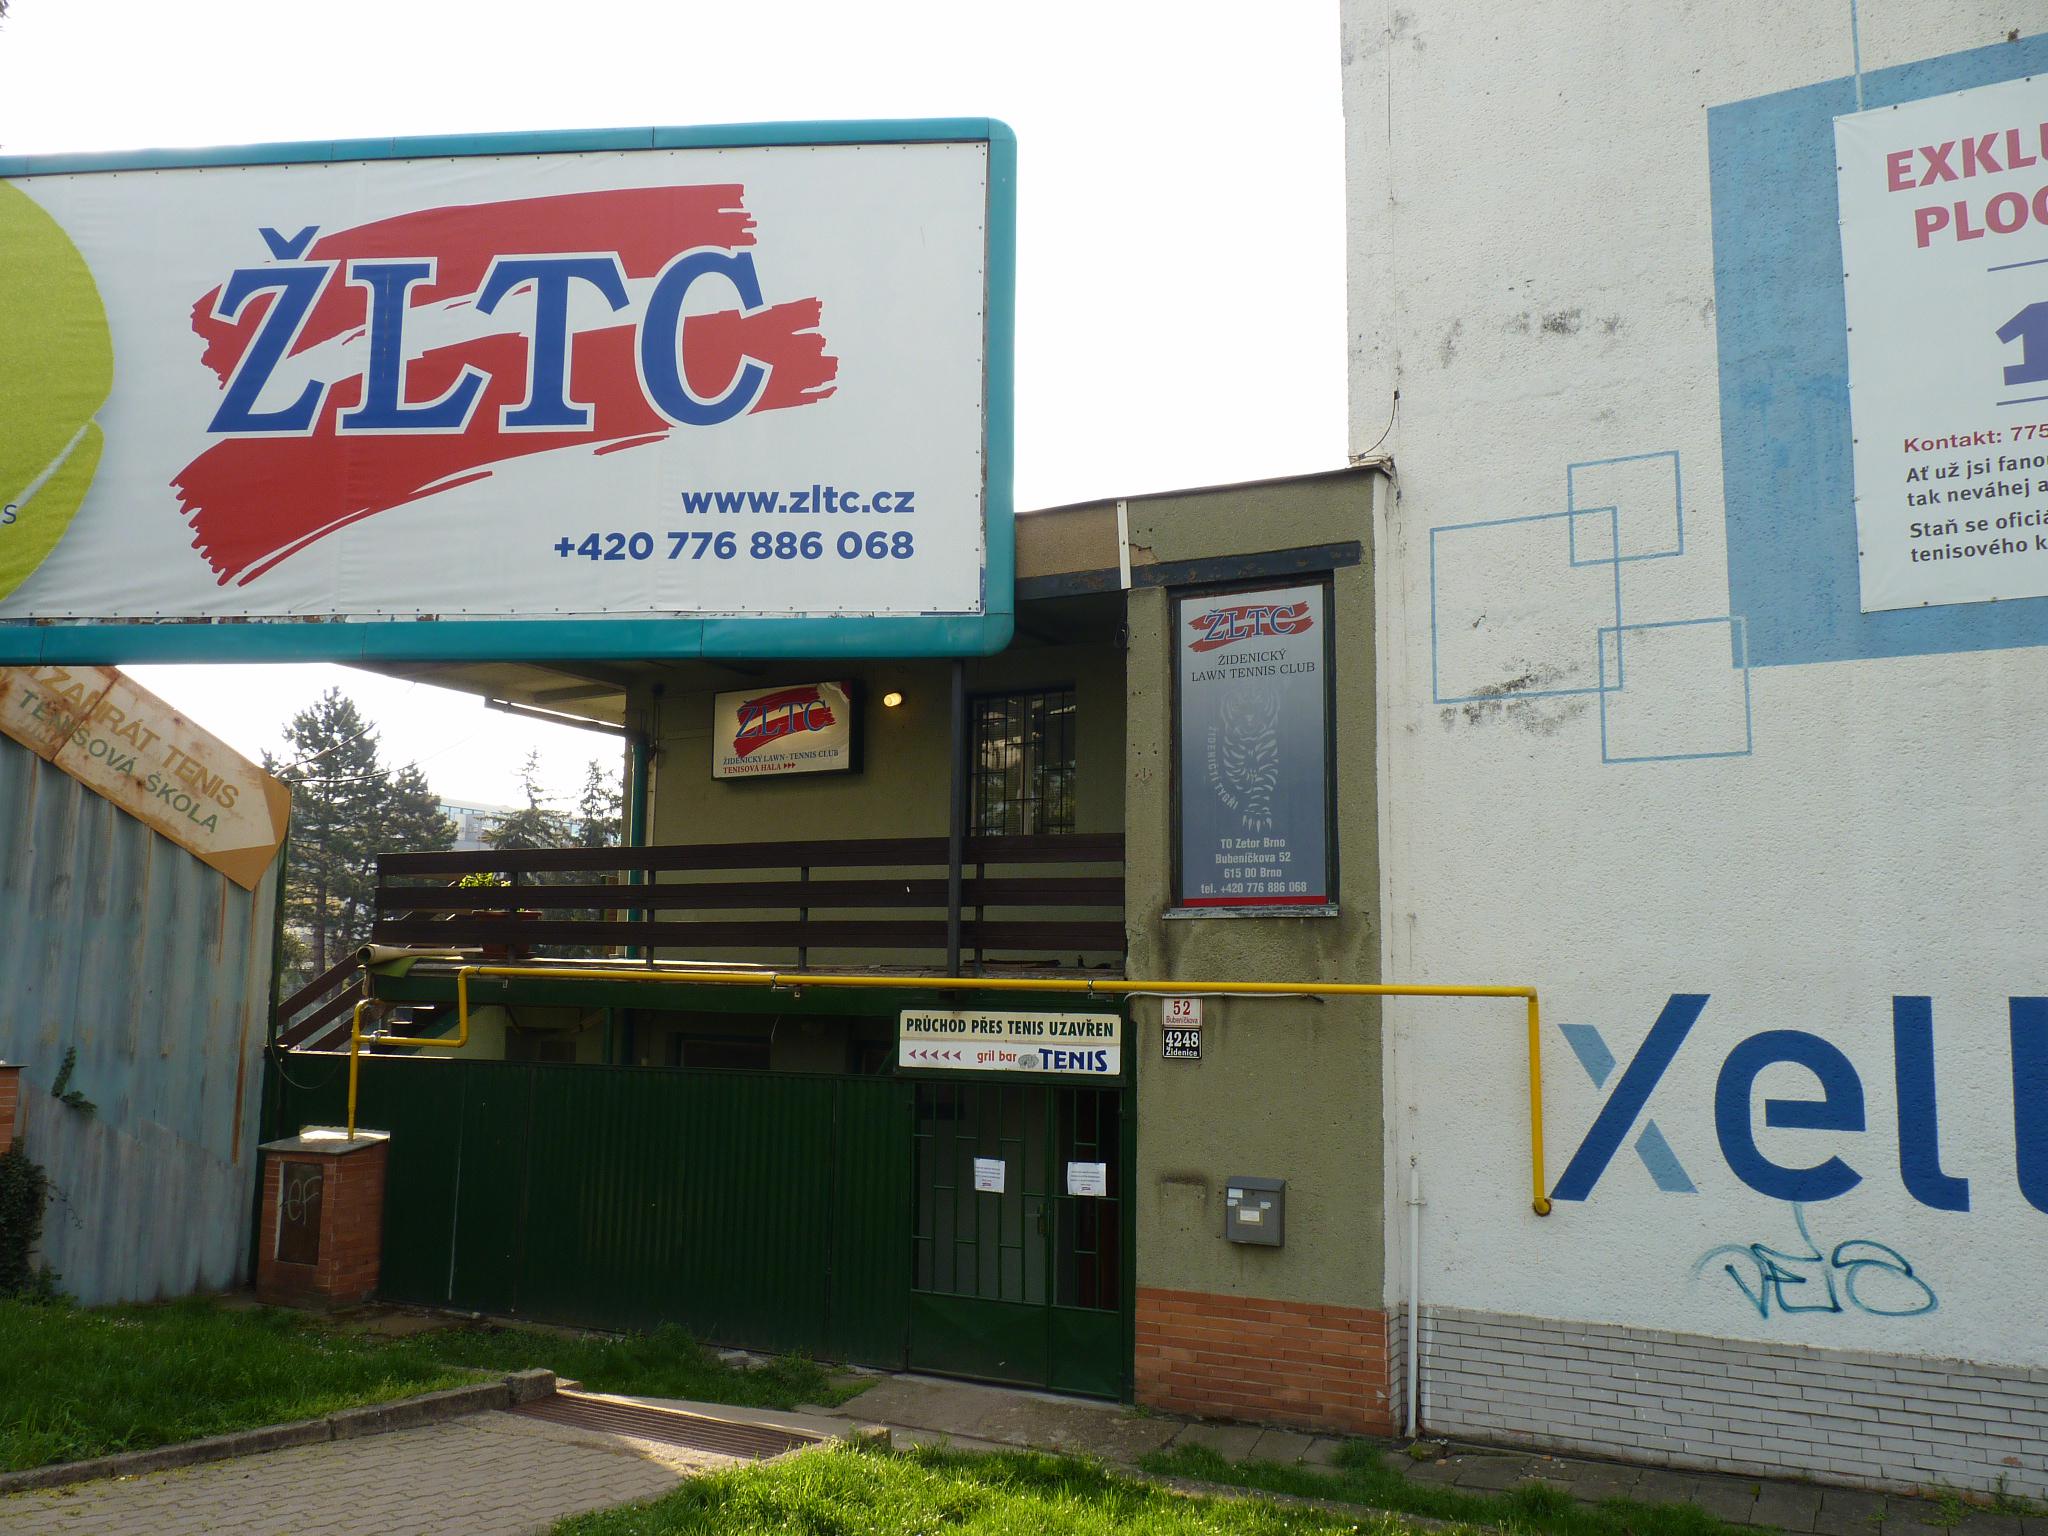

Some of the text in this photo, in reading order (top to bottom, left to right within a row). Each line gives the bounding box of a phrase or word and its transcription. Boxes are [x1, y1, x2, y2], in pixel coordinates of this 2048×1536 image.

[1887, 122, 2048, 193] EXKL
[206, 225, 768, 434] ŽLTC
[1904, 430, 2002, 453] Kontakt:
[1906, 455, 2048, 483] Ať už jsi fano
[681, 484, 915, 514] www.zltc.cz
[1907, 488, 1941, 507] tak
[1947, 478, 2030, 503] neváhej
[1909, 518, 1959, 539] Staň
[1965, 518, 1989, 533] se
[554, 530, 915, 561] +420 776 886 068
[1910, 538, 2028, 563] tenisového
[1203, 605, 1297, 641] ŽLTC
[1218, 648, 1287, 666] ŽIDENICKÝ
[1191, 661, 1315, 682] LAWN TENNIS CLUB
[818, 749, 839, 758] CLUB
[162, 744, 240, 809] TENIS
[761, 763, 781, 771] HALA
[144, 770, 218, 834] ŠKOLA
[1235, 838, 1261, 849] Zetor
[1263, 837, 1286, 848] Brno
[1279, 851, 1292, 862] 52
[1224, 867, 1282, 879] 615 00 Brno
[1201, 881, 1307, 894] tel. +420 776 886 068
[1173, 1000, 1191, 1016] 52
[906, 1015, 1114, 1037] PRŮCHOD PŘES TENIS UZAVŘEN
[1166, 1031, 1199, 1048] 4248
[977, 1048, 1109, 1072] gril bar TENIS
[1166, 1046, 1198, 1057] Židenice
